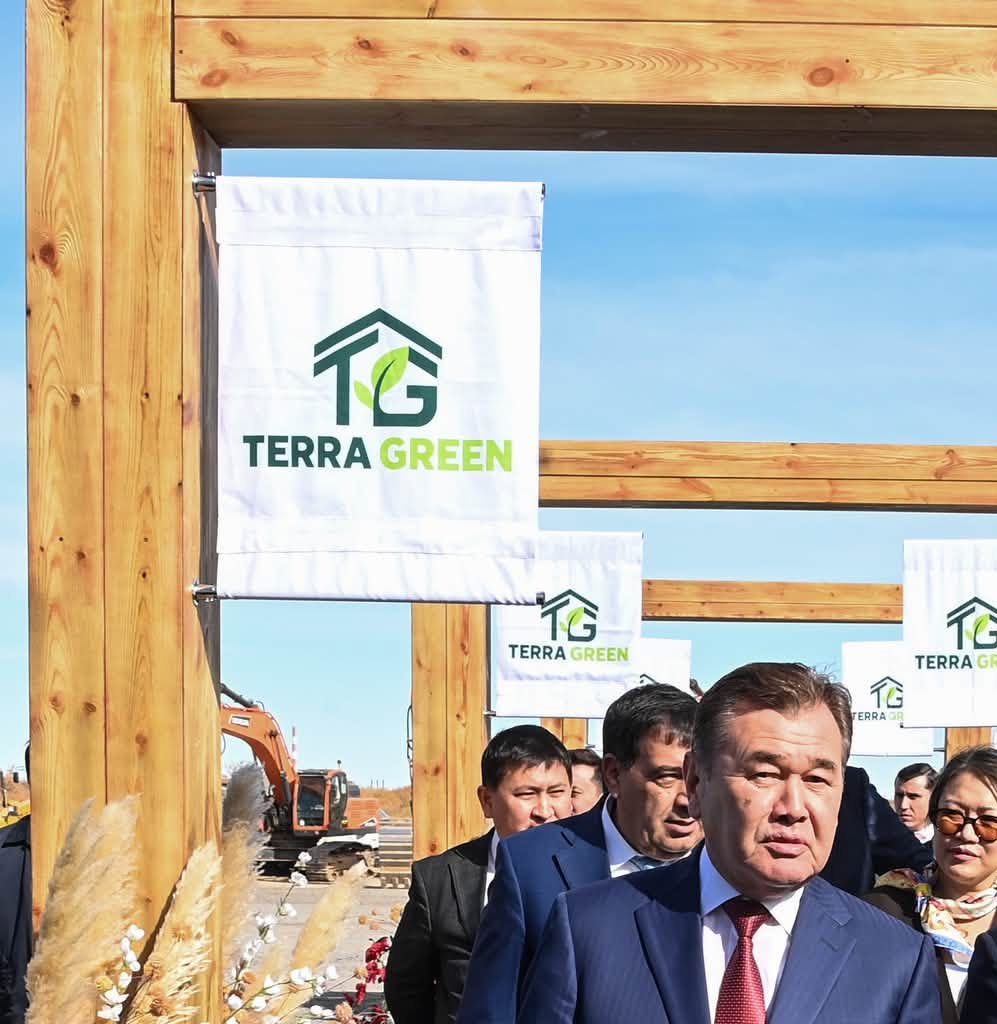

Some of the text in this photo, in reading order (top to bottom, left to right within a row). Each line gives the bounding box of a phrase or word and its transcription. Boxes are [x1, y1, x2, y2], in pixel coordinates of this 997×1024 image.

[242, 434, 513, 473] TERRA GREEN
[508, 644, 630, 663] TERRA GREEN
[914, 654, 973, 670] TERRA
